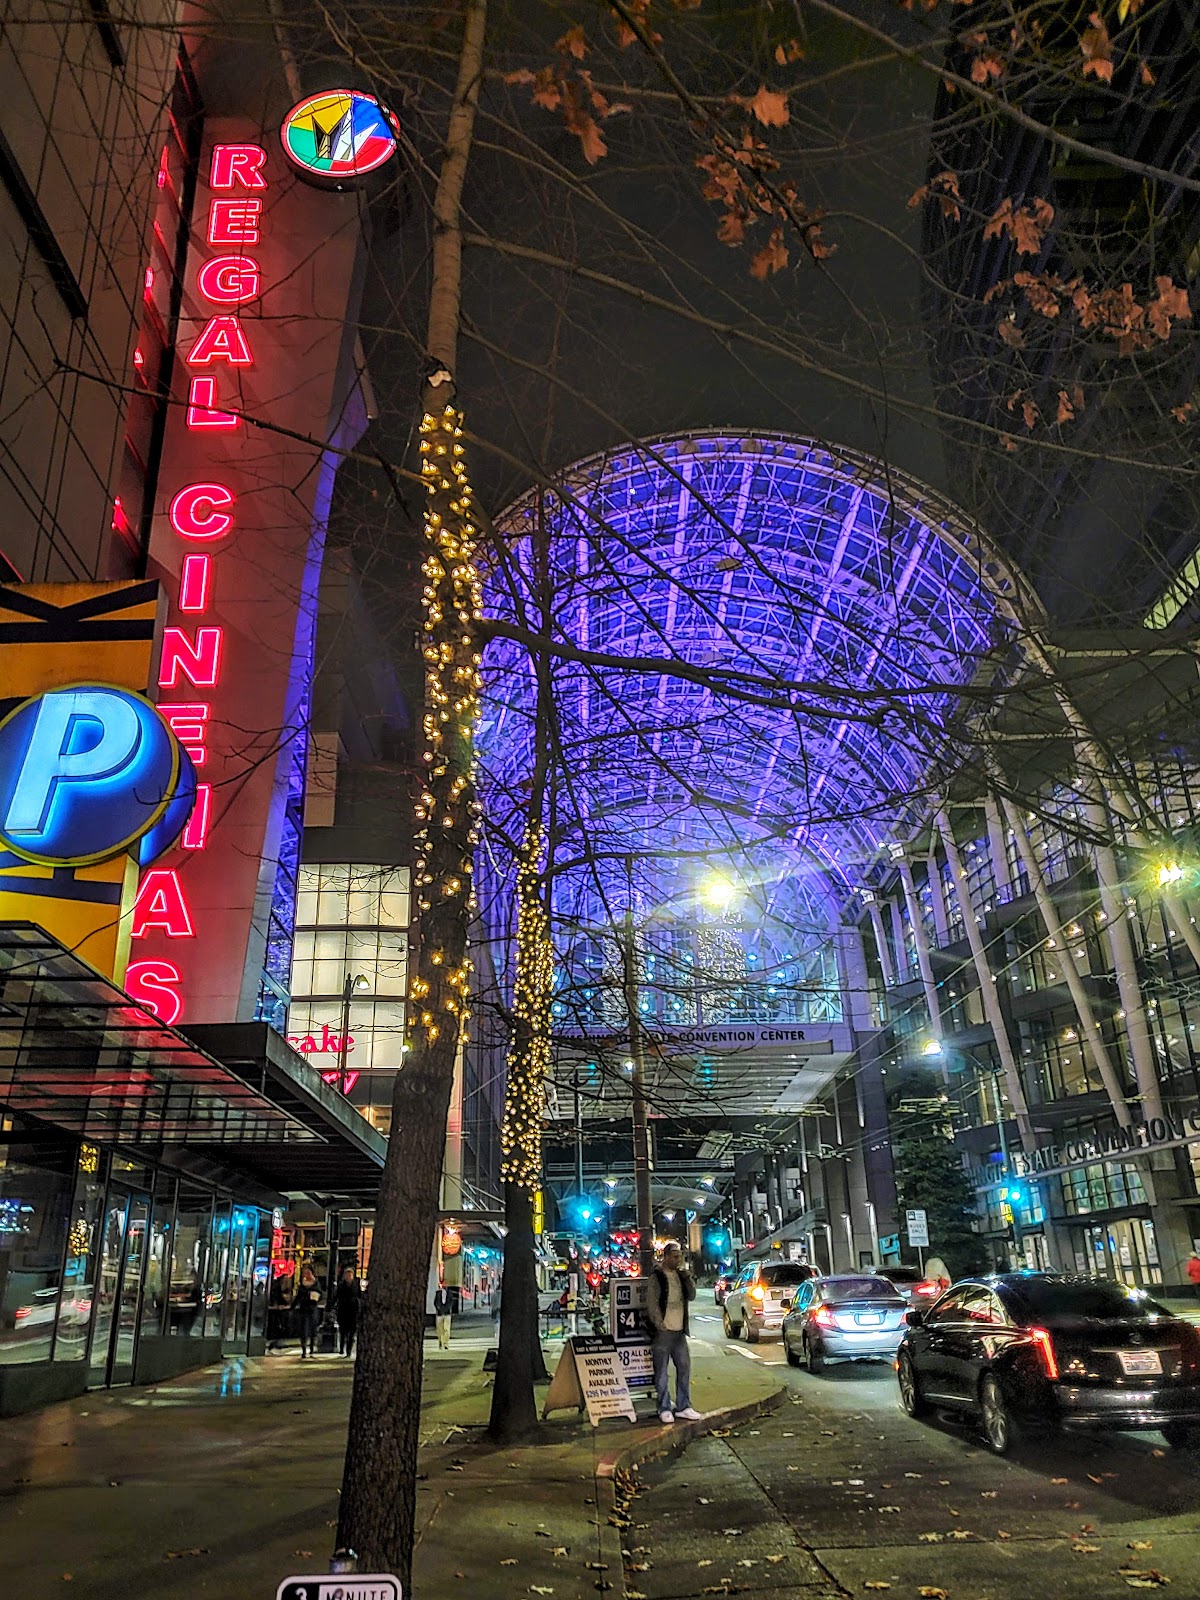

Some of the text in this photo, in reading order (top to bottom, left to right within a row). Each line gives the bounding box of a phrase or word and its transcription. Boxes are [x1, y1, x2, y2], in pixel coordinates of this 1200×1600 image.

[187, 143, 268, 430] REGAL
[3, 692, 142, 836] P
[679, 1031, 755, 1043] CONVENTION
[760, 1030, 806, 1041] CENTER
[617, 1290, 630, 1301] ACE
[620, 1311, 636, 1329] $4
[585, 1358, 612, 1367] MONTHLY
[618, 1350, 630, 1366] $8
[588, 1368, 615, 1377] PARKING
[588, 1378, 620, 1388] AVAILABLE
[600, 1389, 609, 1397] Per
[610, 1387, 628, 1396] Month
